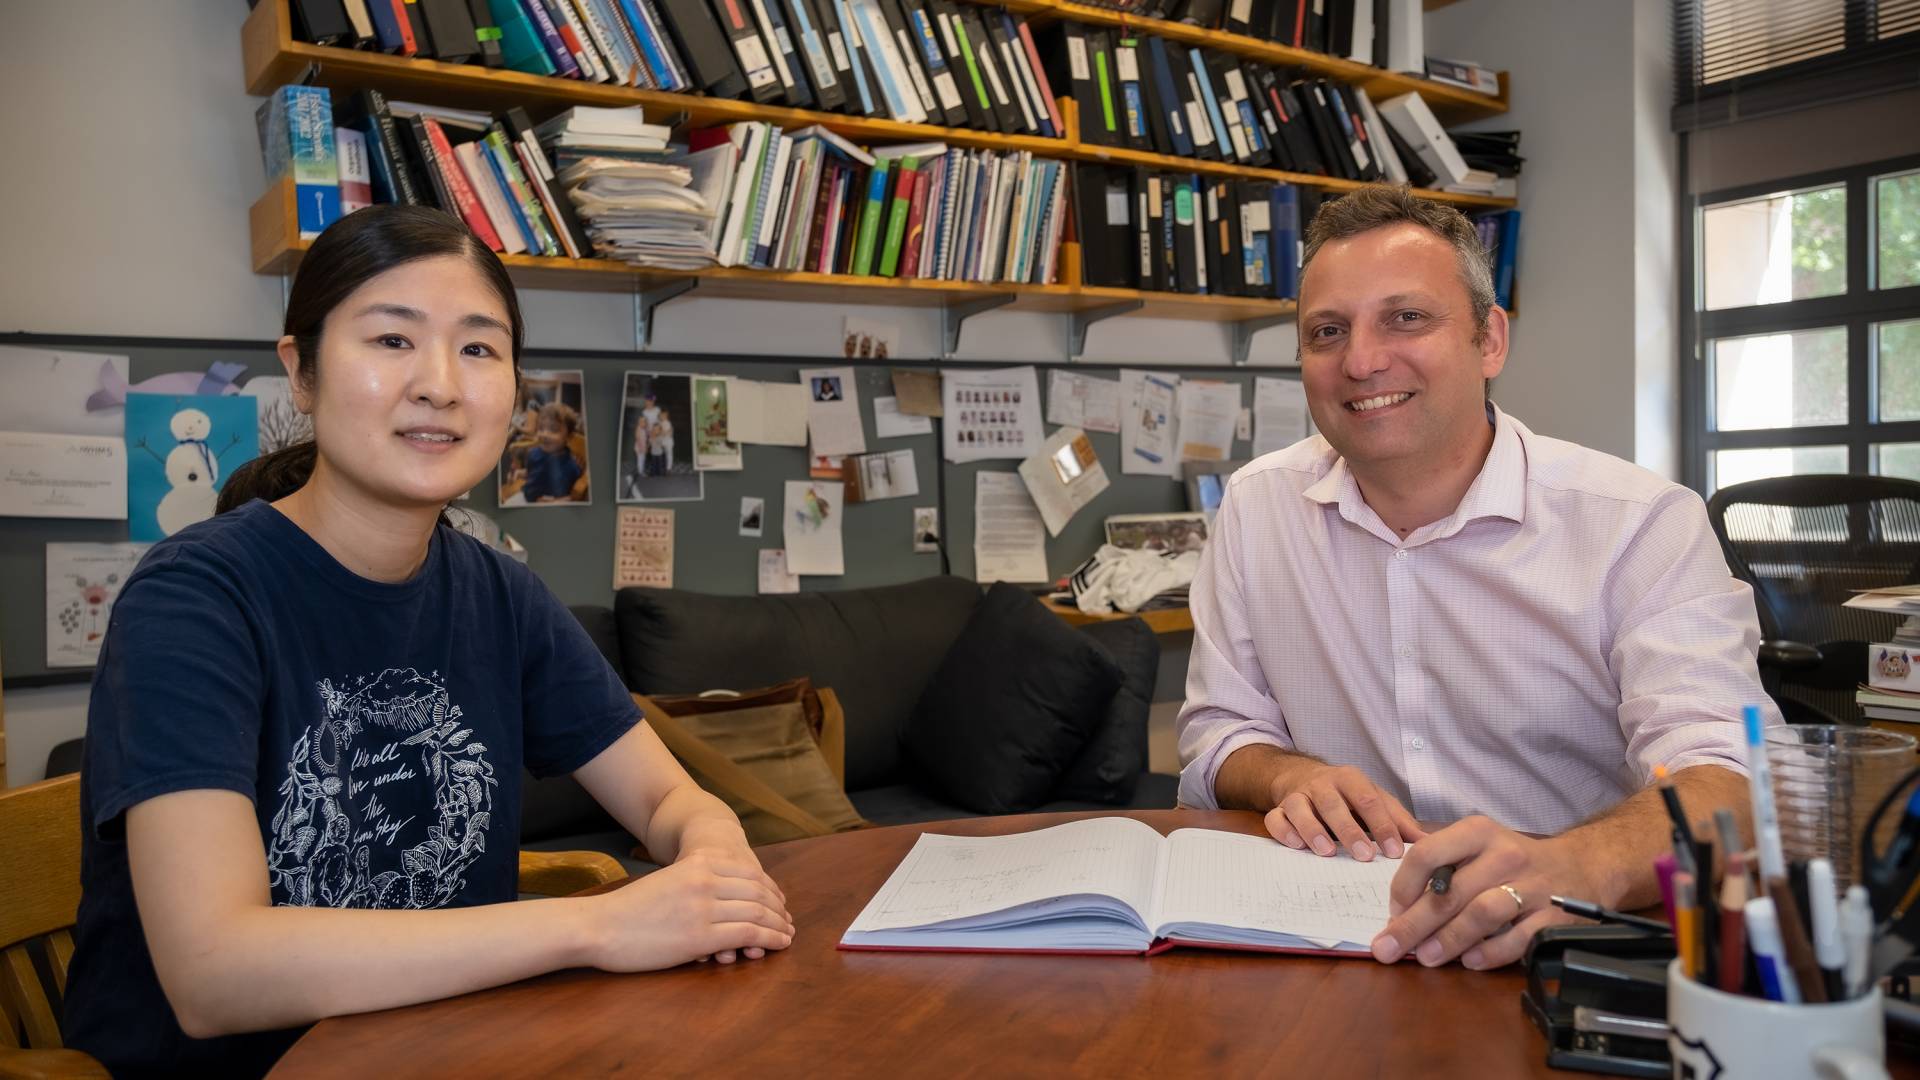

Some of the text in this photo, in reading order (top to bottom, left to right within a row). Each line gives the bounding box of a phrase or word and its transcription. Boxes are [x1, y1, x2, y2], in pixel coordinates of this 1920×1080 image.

[420, 139, 434, 162] RNA
[351, 742, 401, 771] We all
[373, 762, 417, 787] under
